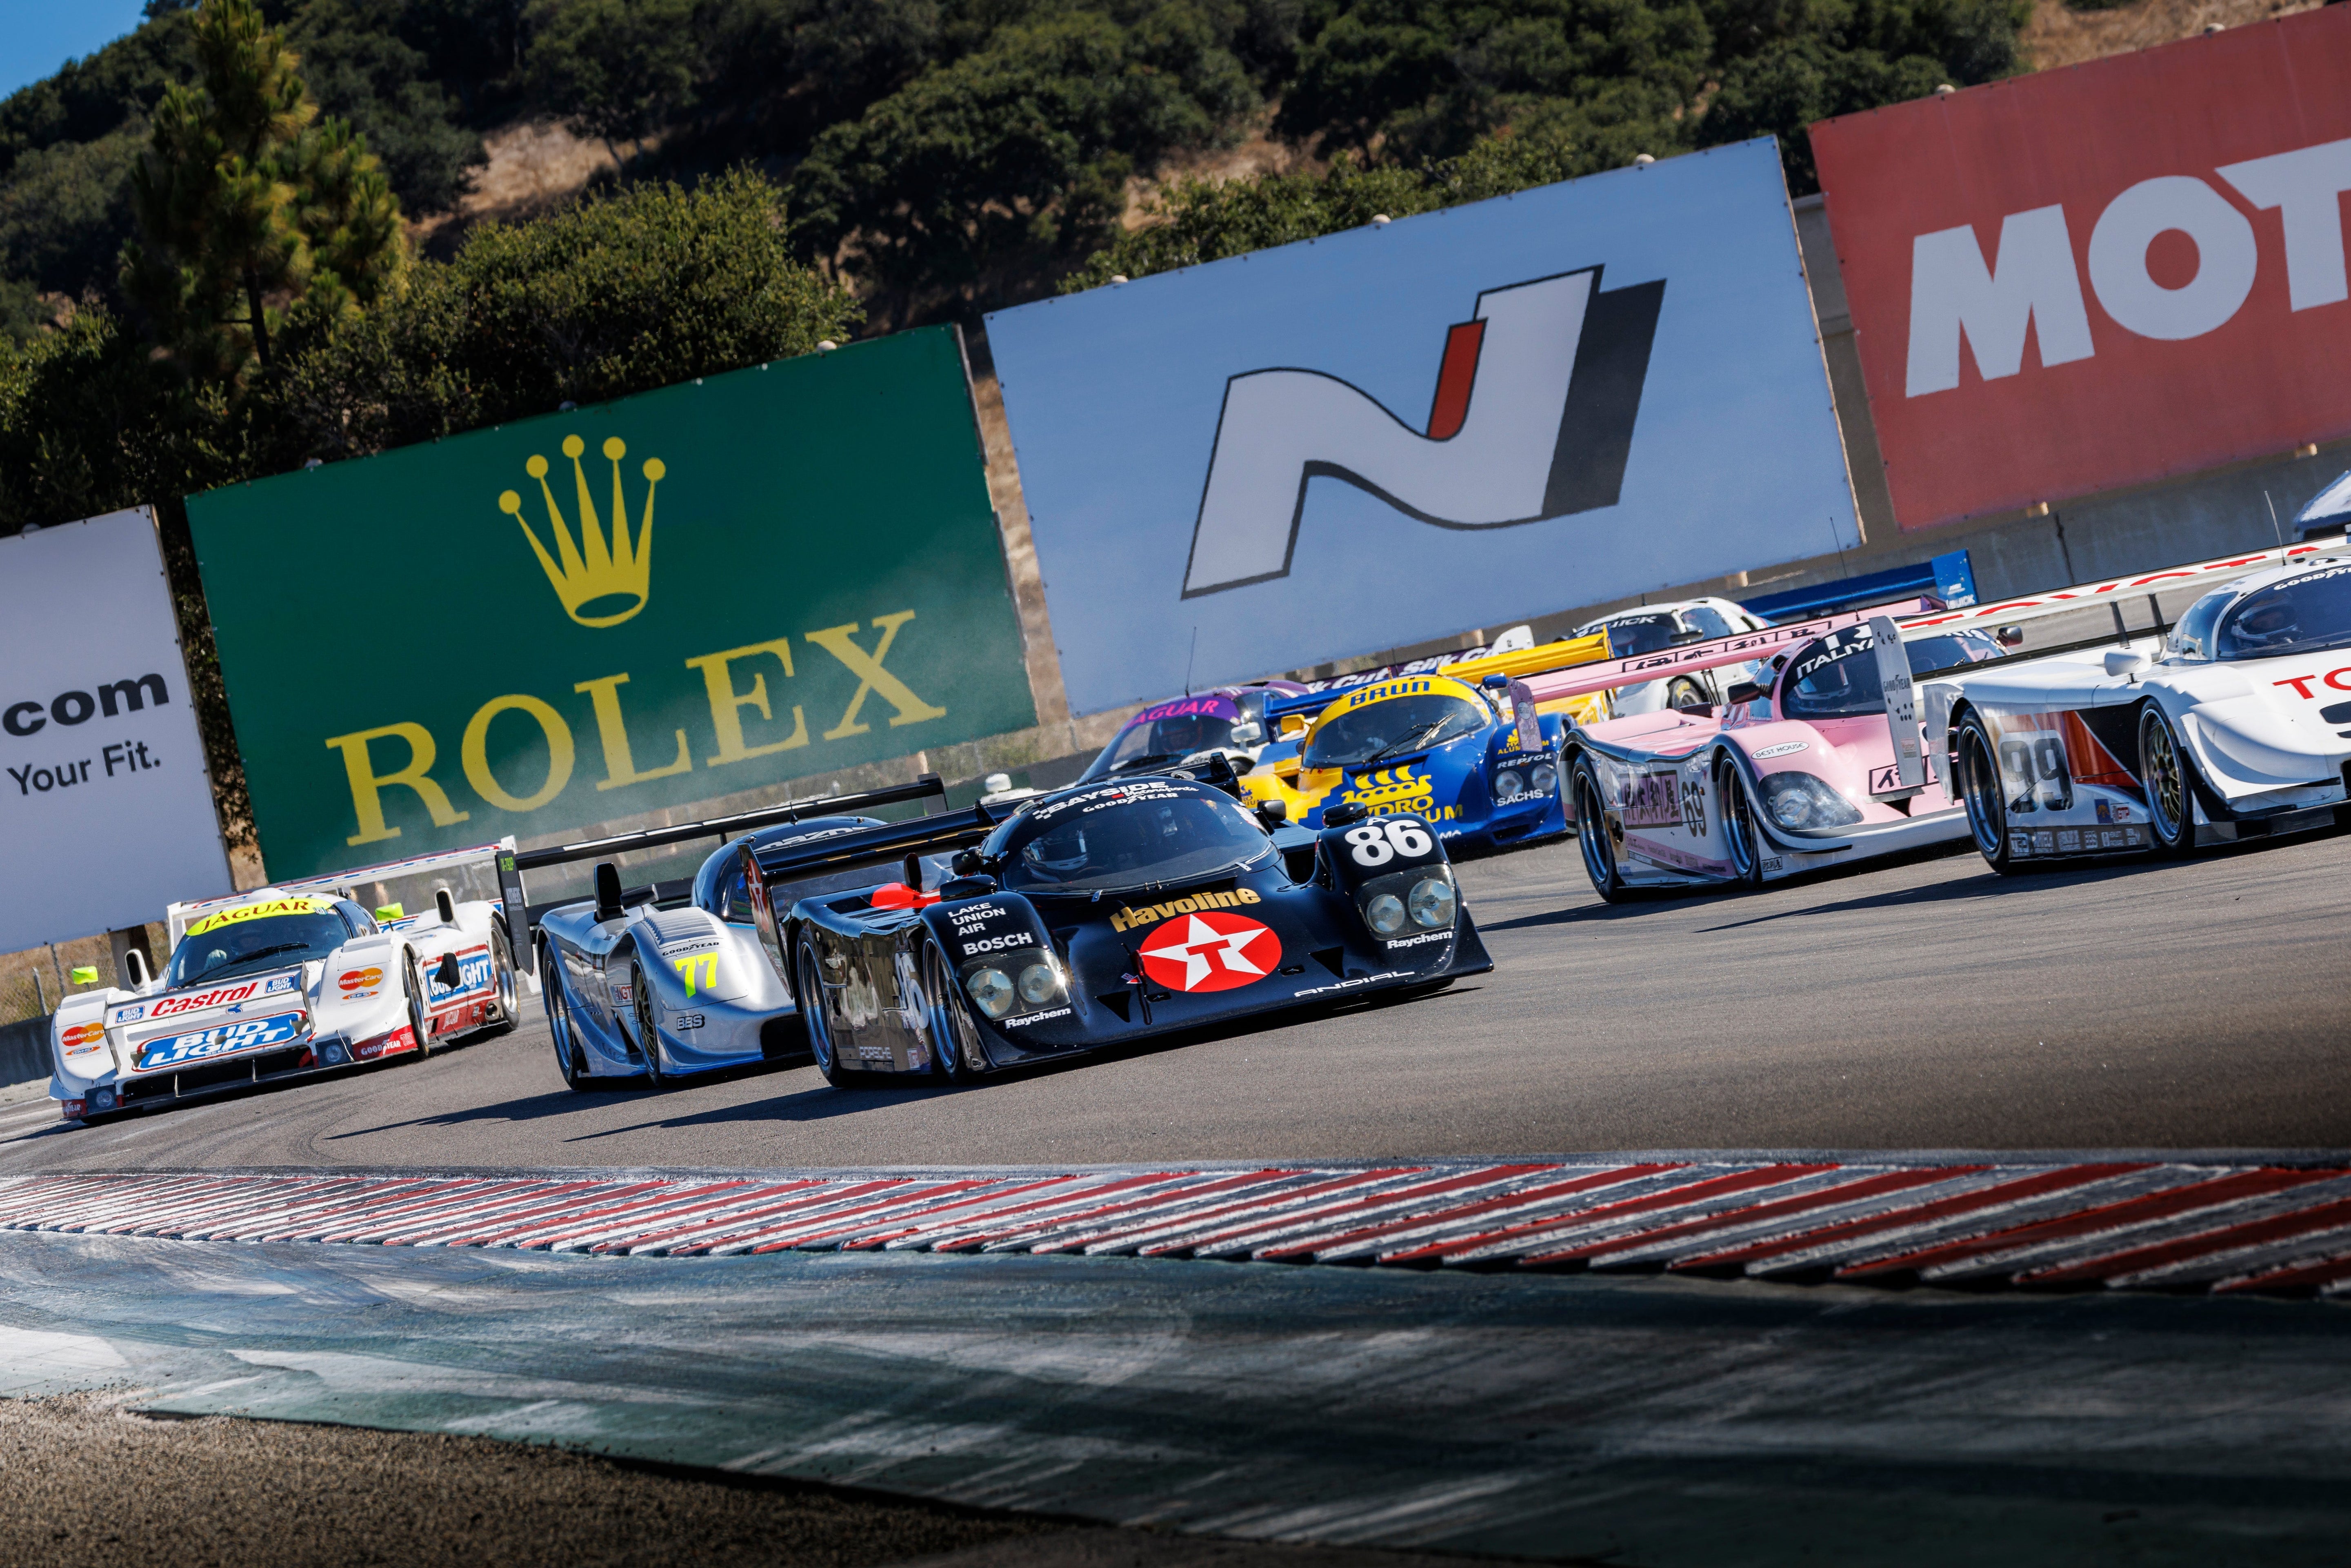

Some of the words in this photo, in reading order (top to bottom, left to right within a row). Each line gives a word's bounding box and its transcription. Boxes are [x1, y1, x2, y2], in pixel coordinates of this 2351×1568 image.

[1350, 681, 1430, 707] BRUN
[2, 673, 169, 736] com
[325, 609, 946, 846] ROLEX
[1755, 749, 1774, 757] BEST
[1776, 743, 1805, 753] HOUSE
[6, 759, 91, 795] Your
[102, 740, 161, 777] Fit.
[1497, 753, 1552, 769] REPSOL
[1047, 782, 1169, 814] BAYSIDE
[1126, 787, 1199, 797] Motorsports
[1497, 789, 1544, 807] SACHS
[1082, 793, 1179, 813] GOODYEAR
[1682, 781, 1707, 837] 69
[1345, 820, 1433, 866] 86
[201, 901, 309, 933] JAGUAR
[948, 902, 992, 918] LAKE
[952, 908, 1007, 925] UNION
[1109, 888, 1261, 933] Havoline
[959, 923, 986, 936] AIR
[662, 942, 719, 956] GOODYEAR
[962, 932, 1033, 955] BOSCH
[1387, 931, 1453, 949] Raychem
[271, 978, 289, 986] BUD
[339, 973, 383, 986] MasterCard
[674, 952, 718, 999] 77
[1294, 971, 1415, 997] ANDIAL
[267, 982, 293, 992] LIGHT
[151, 982, 258, 1016] Castrol
[117, 1012, 142, 1022] LIGHT
[122, 1008, 140, 1016] BUD
[1005, 1008, 1071, 1029] Raychem
[677, 1014, 705, 1031] BBS
[173, 1021, 269, 1050] BUD
[148, 1027, 287, 1066] LIGHT
[361, 1039, 400, 1056] GOODYEAR
